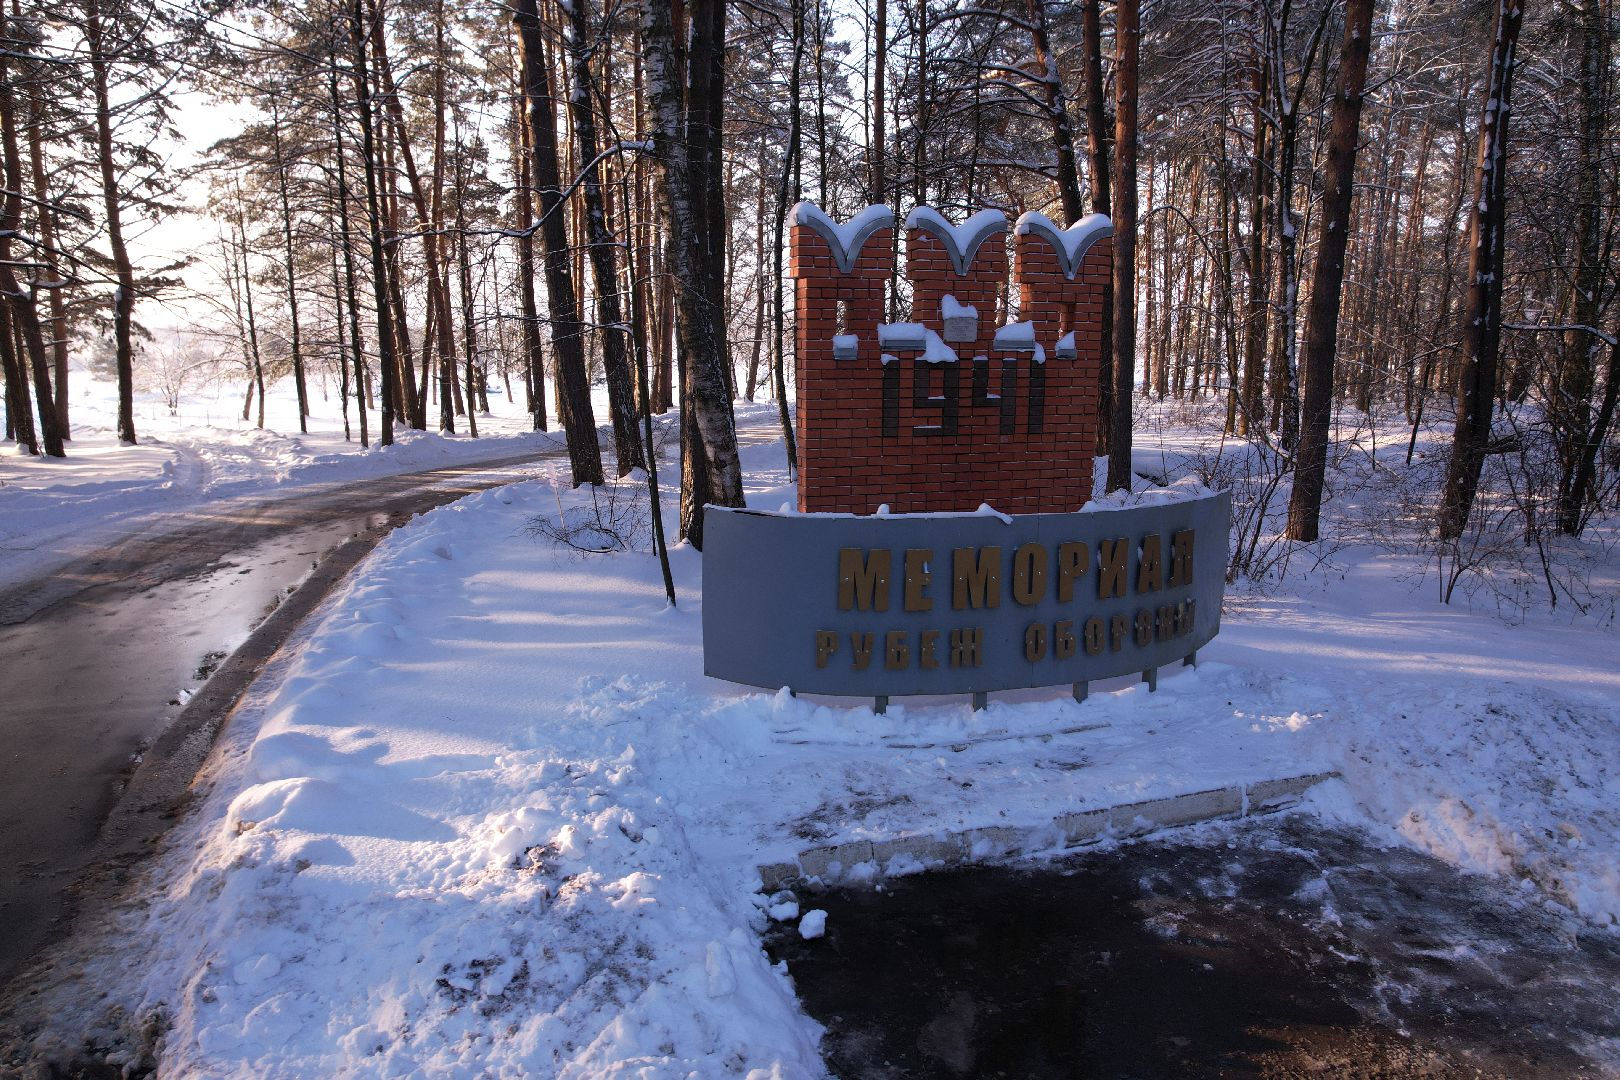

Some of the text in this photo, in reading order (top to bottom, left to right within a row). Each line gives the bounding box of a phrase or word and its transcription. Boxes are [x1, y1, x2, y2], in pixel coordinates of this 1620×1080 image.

[881, 359, 1046, 437] 1941
[838, 529, 1195, 612] МЕМОРИАЛ
[815, 627, 984, 670] РУБЕЖ
